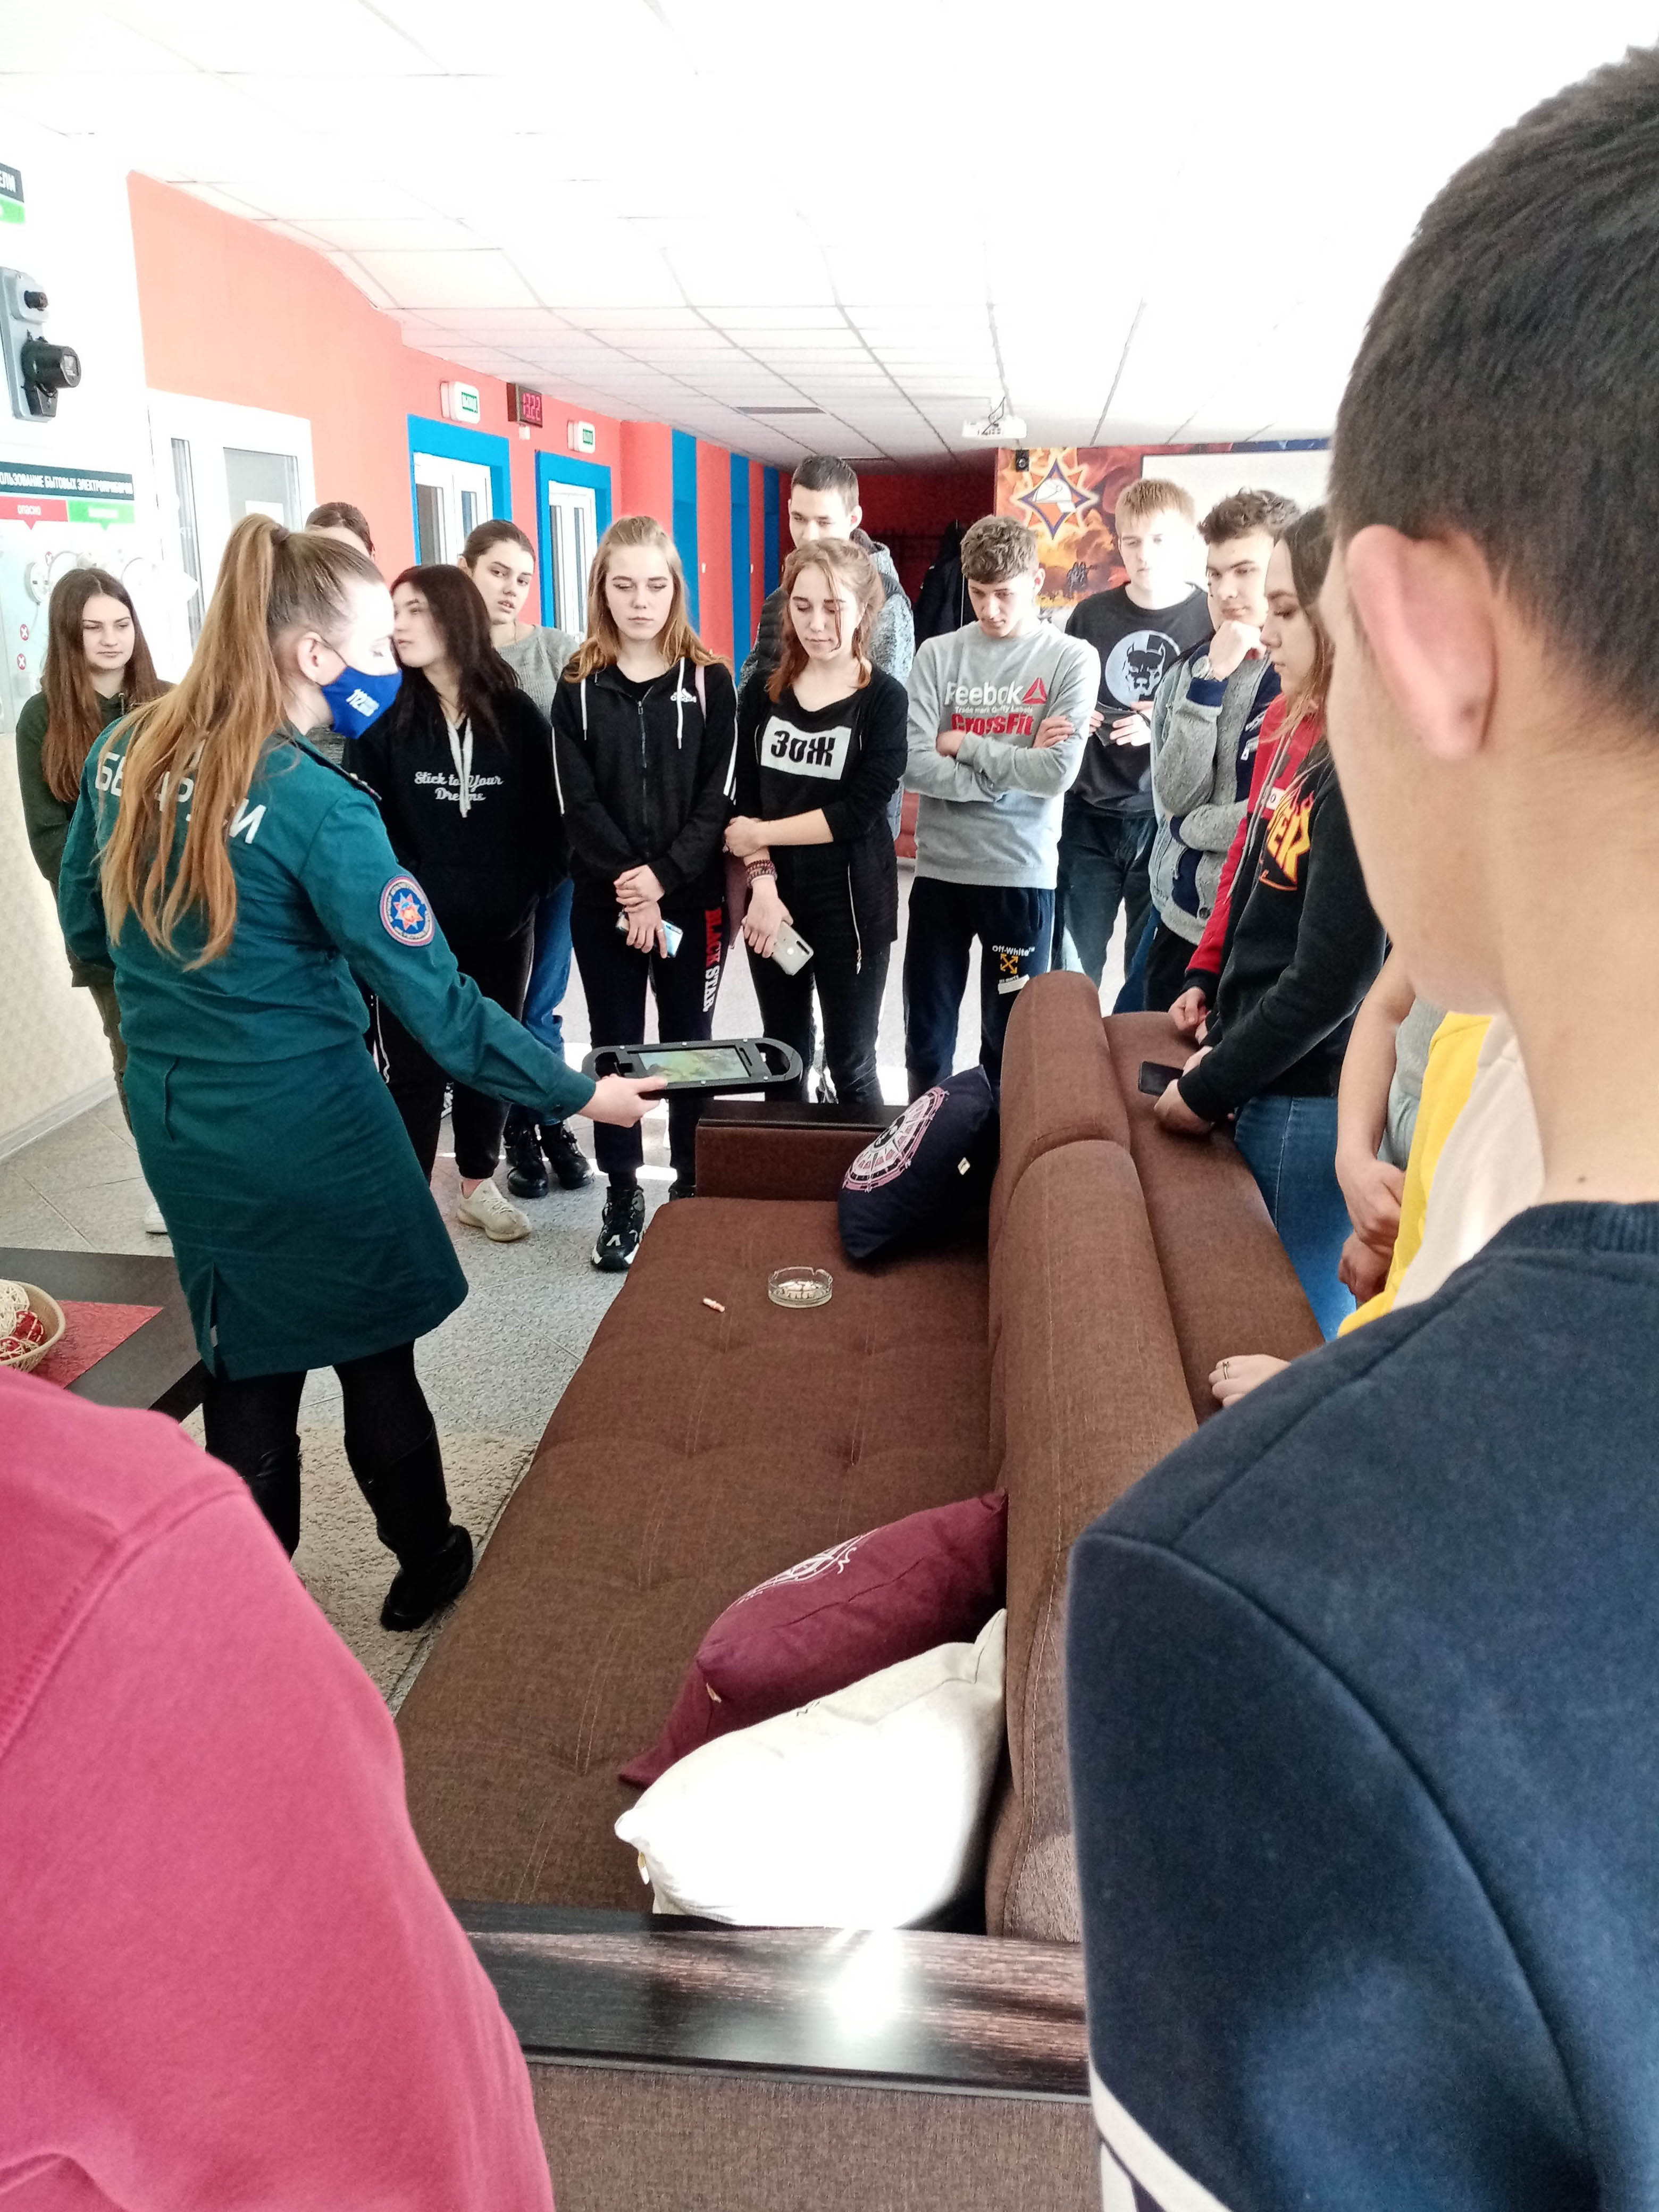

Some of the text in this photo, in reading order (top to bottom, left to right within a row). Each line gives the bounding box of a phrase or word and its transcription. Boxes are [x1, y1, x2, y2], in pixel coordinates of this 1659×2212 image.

[414, 772, 505, 792] Stick to Your
[434, 787, 487, 801] Drems
[697, 966, 720, 1012] STAR
